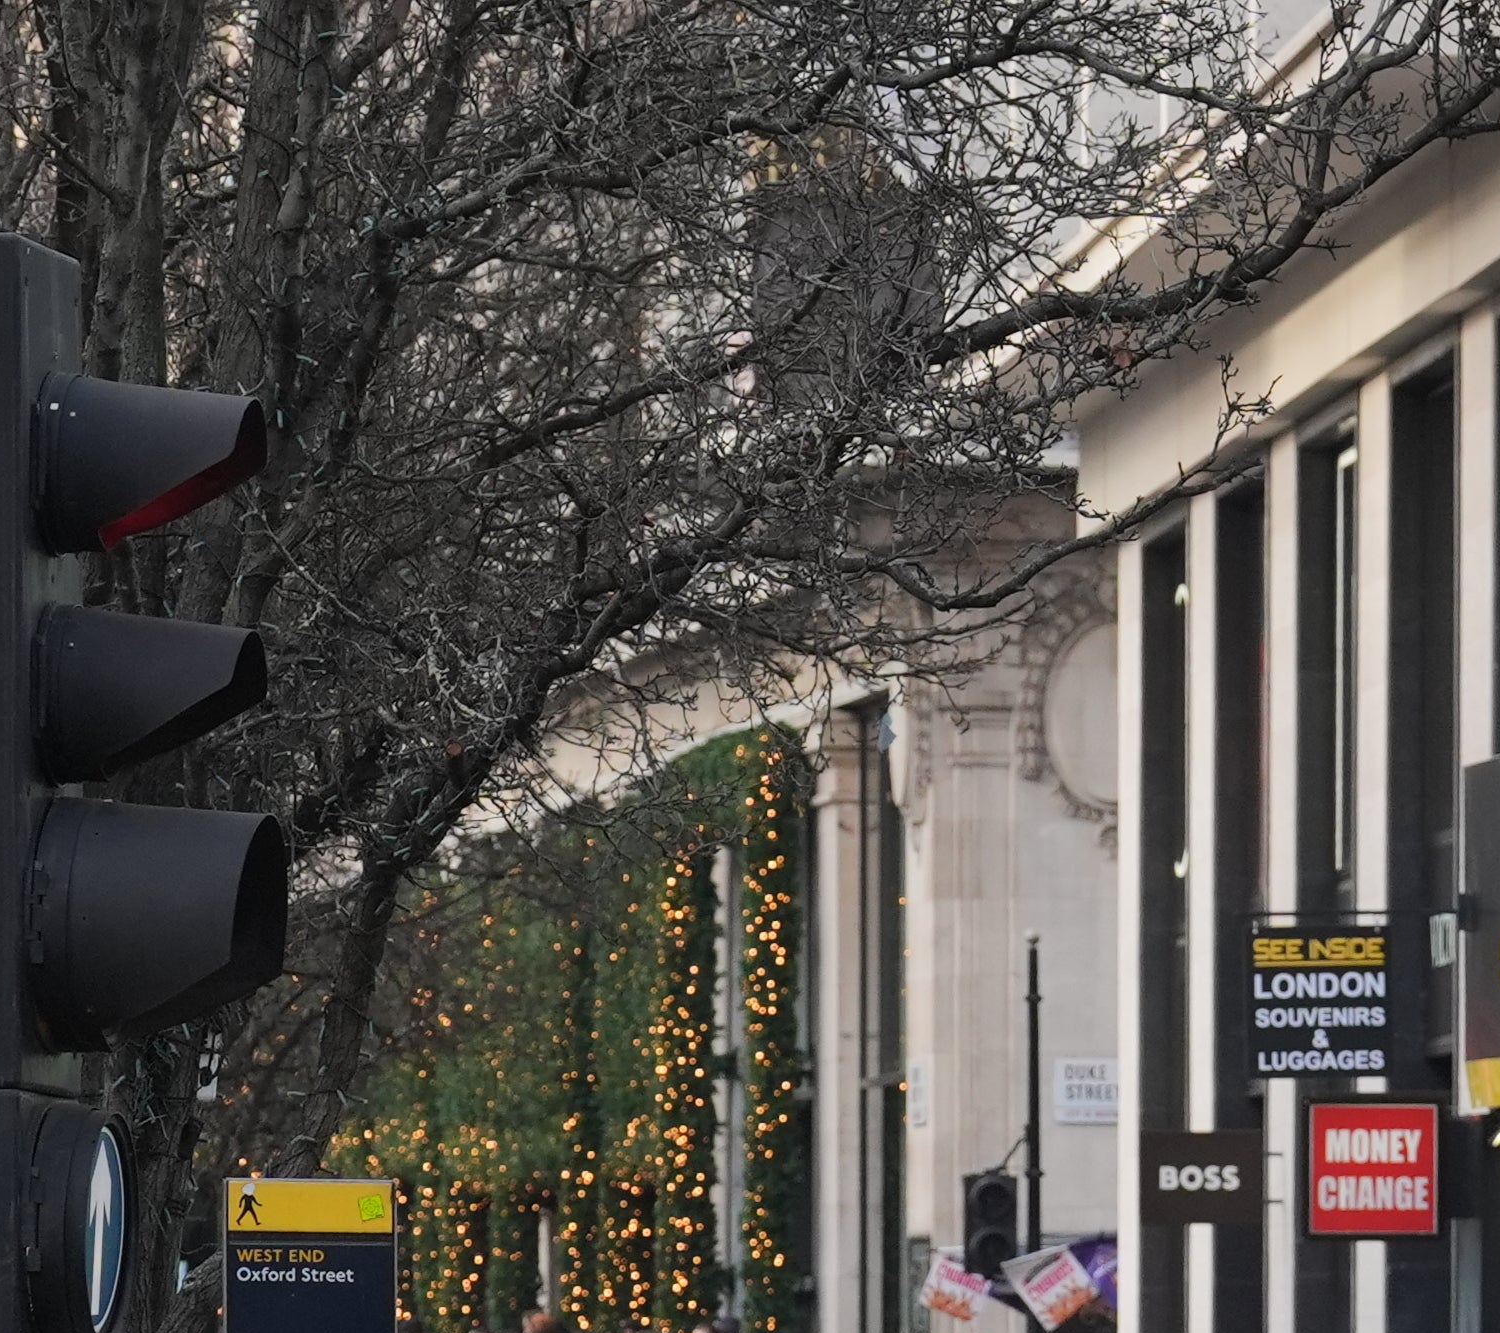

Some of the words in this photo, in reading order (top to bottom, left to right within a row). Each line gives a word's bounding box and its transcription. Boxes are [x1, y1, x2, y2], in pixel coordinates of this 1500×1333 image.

[1253, 938, 1304, 960] SEE
[1309, 938, 1386, 960] INSIDE
[1253, 972, 1386, 999] LONDON
[1255, 1007, 1386, 1027] SOUVENIRS
[1312, 1029, 1329, 1048] &
[1258, 1051, 1385, 1071] LUGGAGES
[1325, 1128, 1423, 1163] MONEY
[1158, 1165, 1240, 1191] BOSS
[1317, 1176, 1430, 1211] CHANGE
[236, 1249, 283, 1263] WEST
[288, 1249, 325, 1263] END
[236, 1266, 296, 1282] Oxford
[301, 1267, 354, 1282] Street
